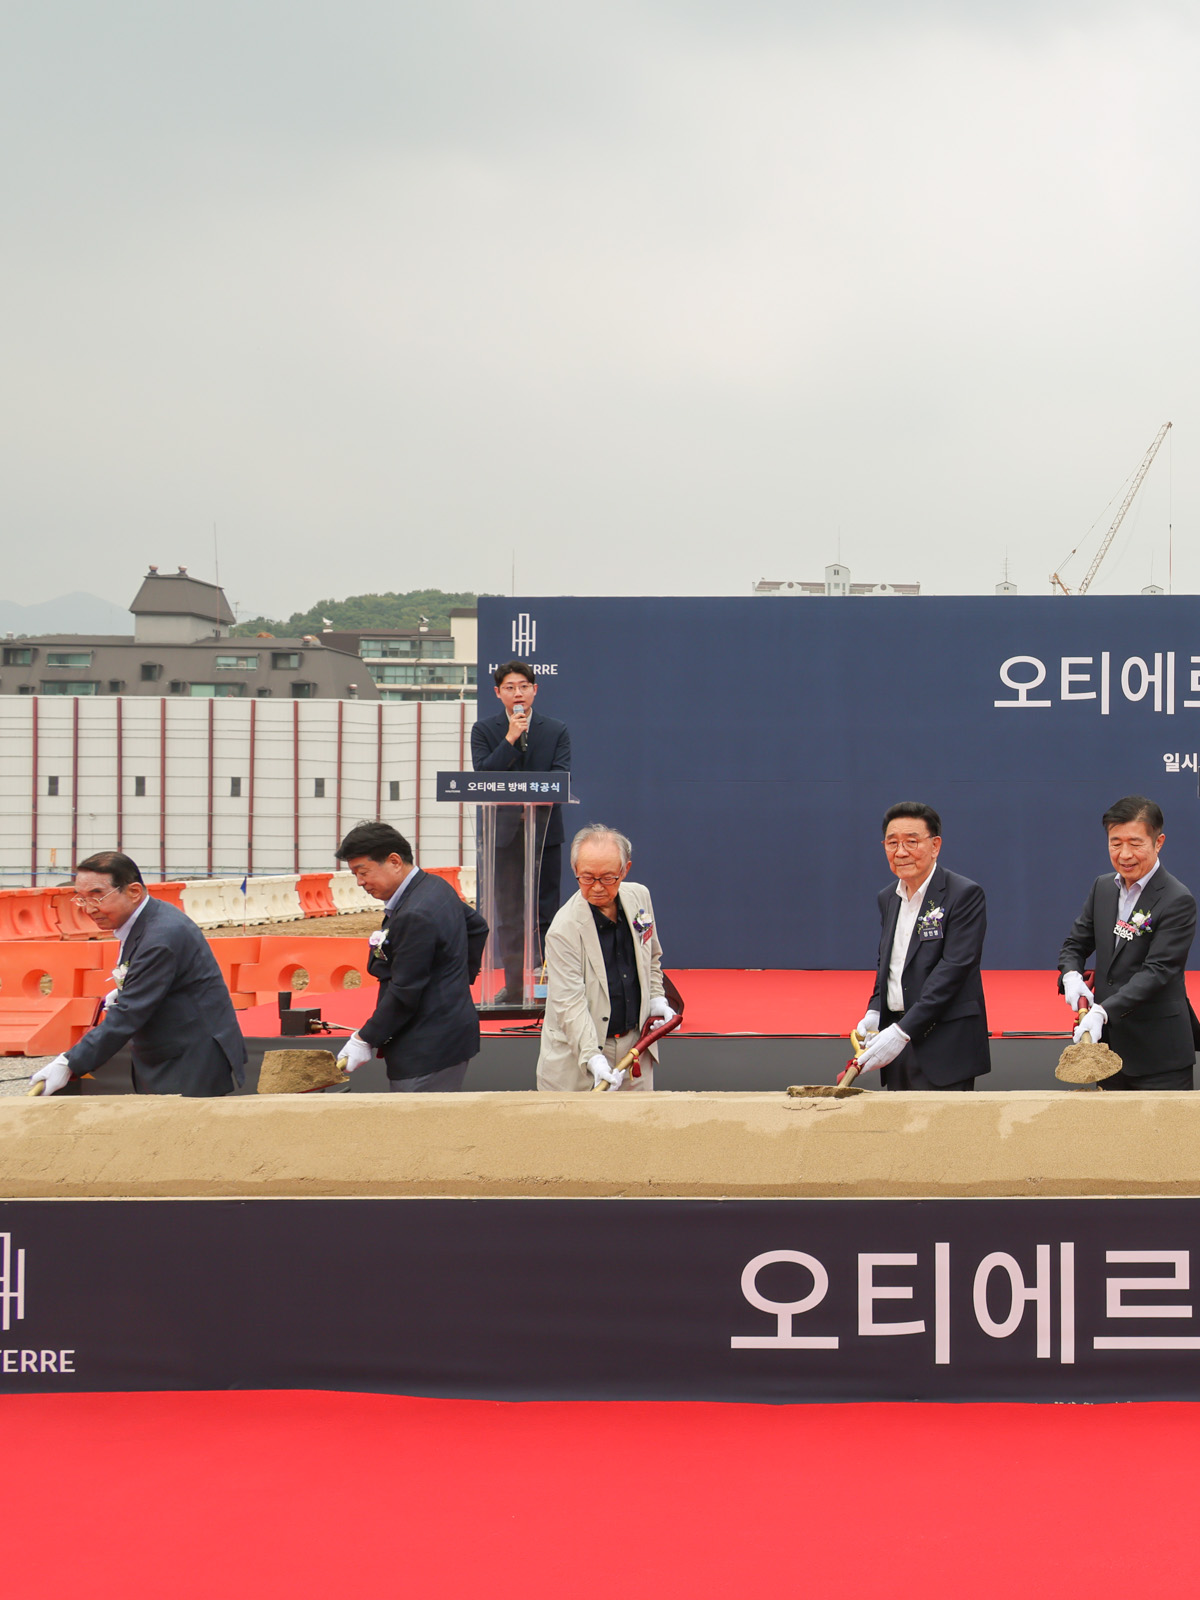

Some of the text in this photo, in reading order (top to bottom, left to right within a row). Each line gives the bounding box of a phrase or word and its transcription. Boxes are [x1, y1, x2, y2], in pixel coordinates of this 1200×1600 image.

[488, 663, 558, 675] HRRE
[1162, 752, 1198, 773] 일시
[467, 781, 560, 793] 오티에르 방배 착공식
[0, 1349, 76, 1373] ERRE
